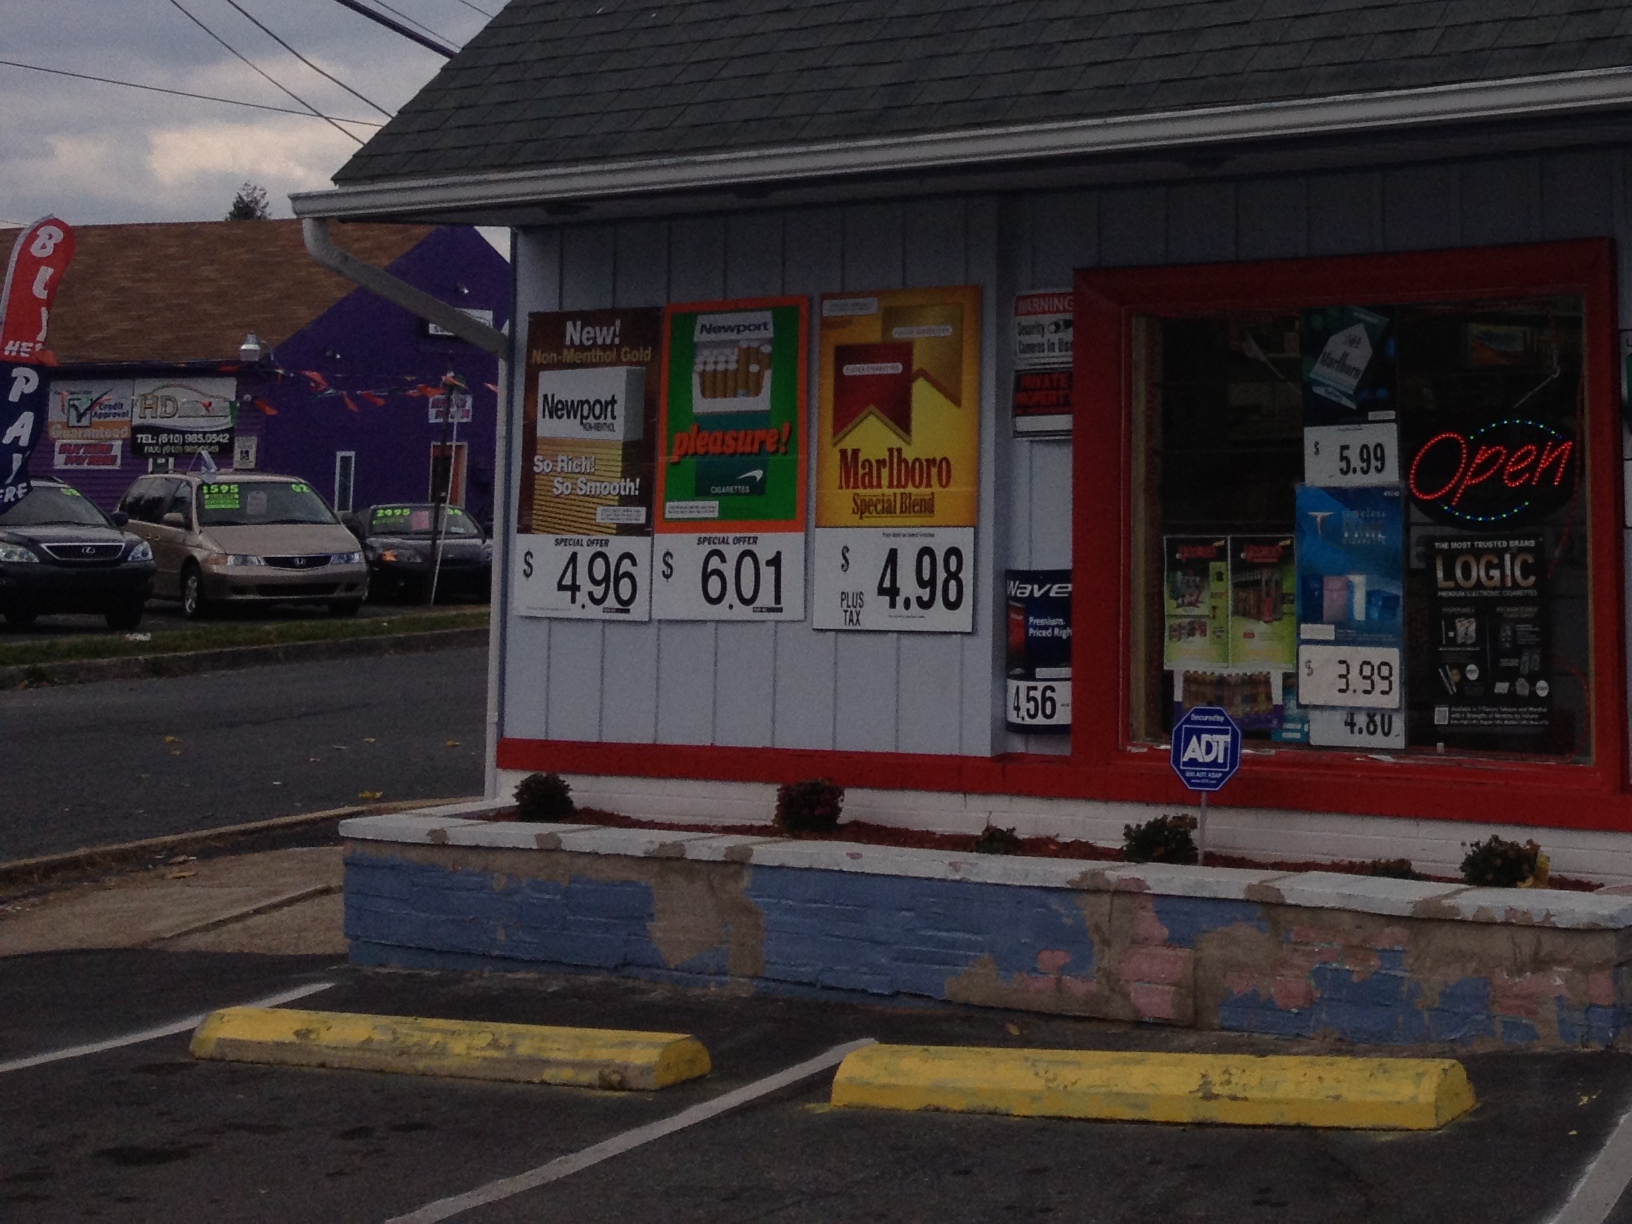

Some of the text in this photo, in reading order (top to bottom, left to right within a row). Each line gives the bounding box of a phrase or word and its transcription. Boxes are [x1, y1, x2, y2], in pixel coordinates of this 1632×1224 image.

[1017, 295, 1073, 314] WARNING
[565, 319, 621, 346] New!
[699, 320, 770, 335] Newport
[531, 346, 651, 364] Non-Menthol Gold
[92, 410, 129, 421] Approval
[137, 393, 179, 419] HD
[542, 393, 618, 423] Newport
[136, 433, 157, 444] TEL:
[671, 422, 793, 465] pleasure!
[533, 454, 596, 474] So Rich!
[838, 447, 952, 490] Marlboro
[1338, 442, 1386, 475] 5.99
[1408, 431, 1574, 506] Open
[553, 476, 641, 497] So Smooth!
[852, 492, 935, 519] Special Blend
[554, 537, 610, 548] SPECIAL OFFER
[696, 536, 759, 546] SPECIAL OFFER
[1434, 539, 1536, 550] THE MOST TRUSTED BRAND
[523, 550, 638, 610] $ 4.96
[662, 548, 782, 610] $ 6.01
[841, 545, 964, 612] $ 4.98
[1434, 552, 1537, 589] LOGIC
[840, 591, 864, 608] PLUS
[1006, 579, 1073, 598] Wave
[842, 609, 862, 626] TAX
[1028, 627, 1073, 640] Priced Righ
[1337, 659, 1393, 695] 3.99
[1013, 685, 1057, 721] 4.56
[1182, 733, 1231, 764] ADT
